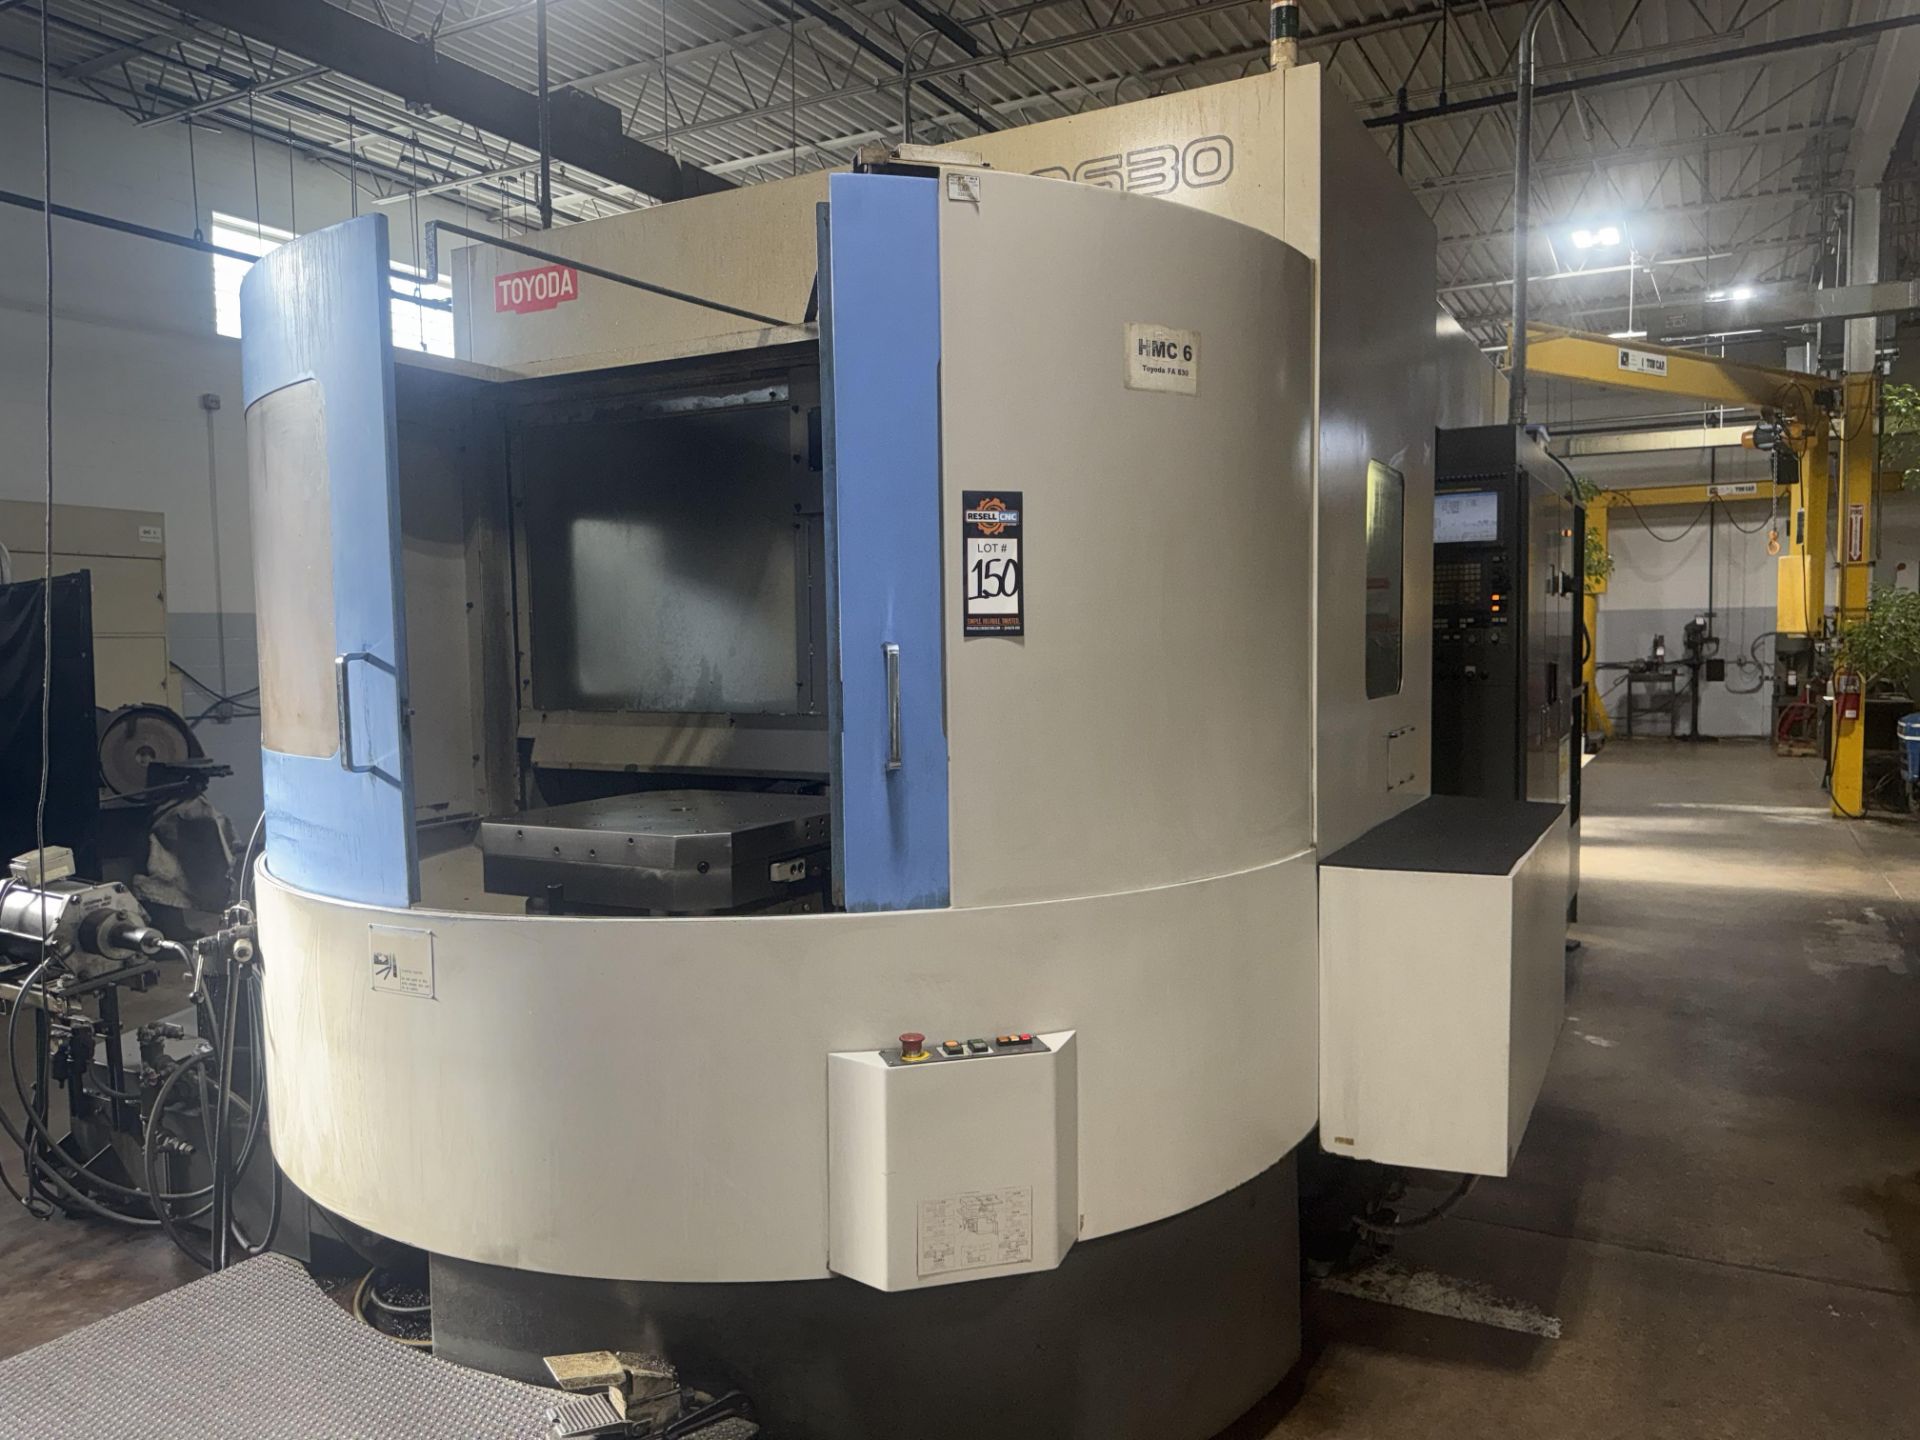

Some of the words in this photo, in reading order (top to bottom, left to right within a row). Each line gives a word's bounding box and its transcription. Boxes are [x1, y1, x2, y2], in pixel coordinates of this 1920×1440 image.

[1030, 135, 1233, 196] 630
[499, 269, 573, 305] TOYODA
[1138, 338, 1178, 359] HMC
[1183, 345, 1192, 361] 6
[1142, 364, 1166, 374] Toyoda
[967, 512, 998, 520] RESELL
[999, 512, 1017, 521] CNC
[977, 543, 998, 553] LOT
[1001, 543, 1007, 553] #
[968, 558, 1019, 600] 150
